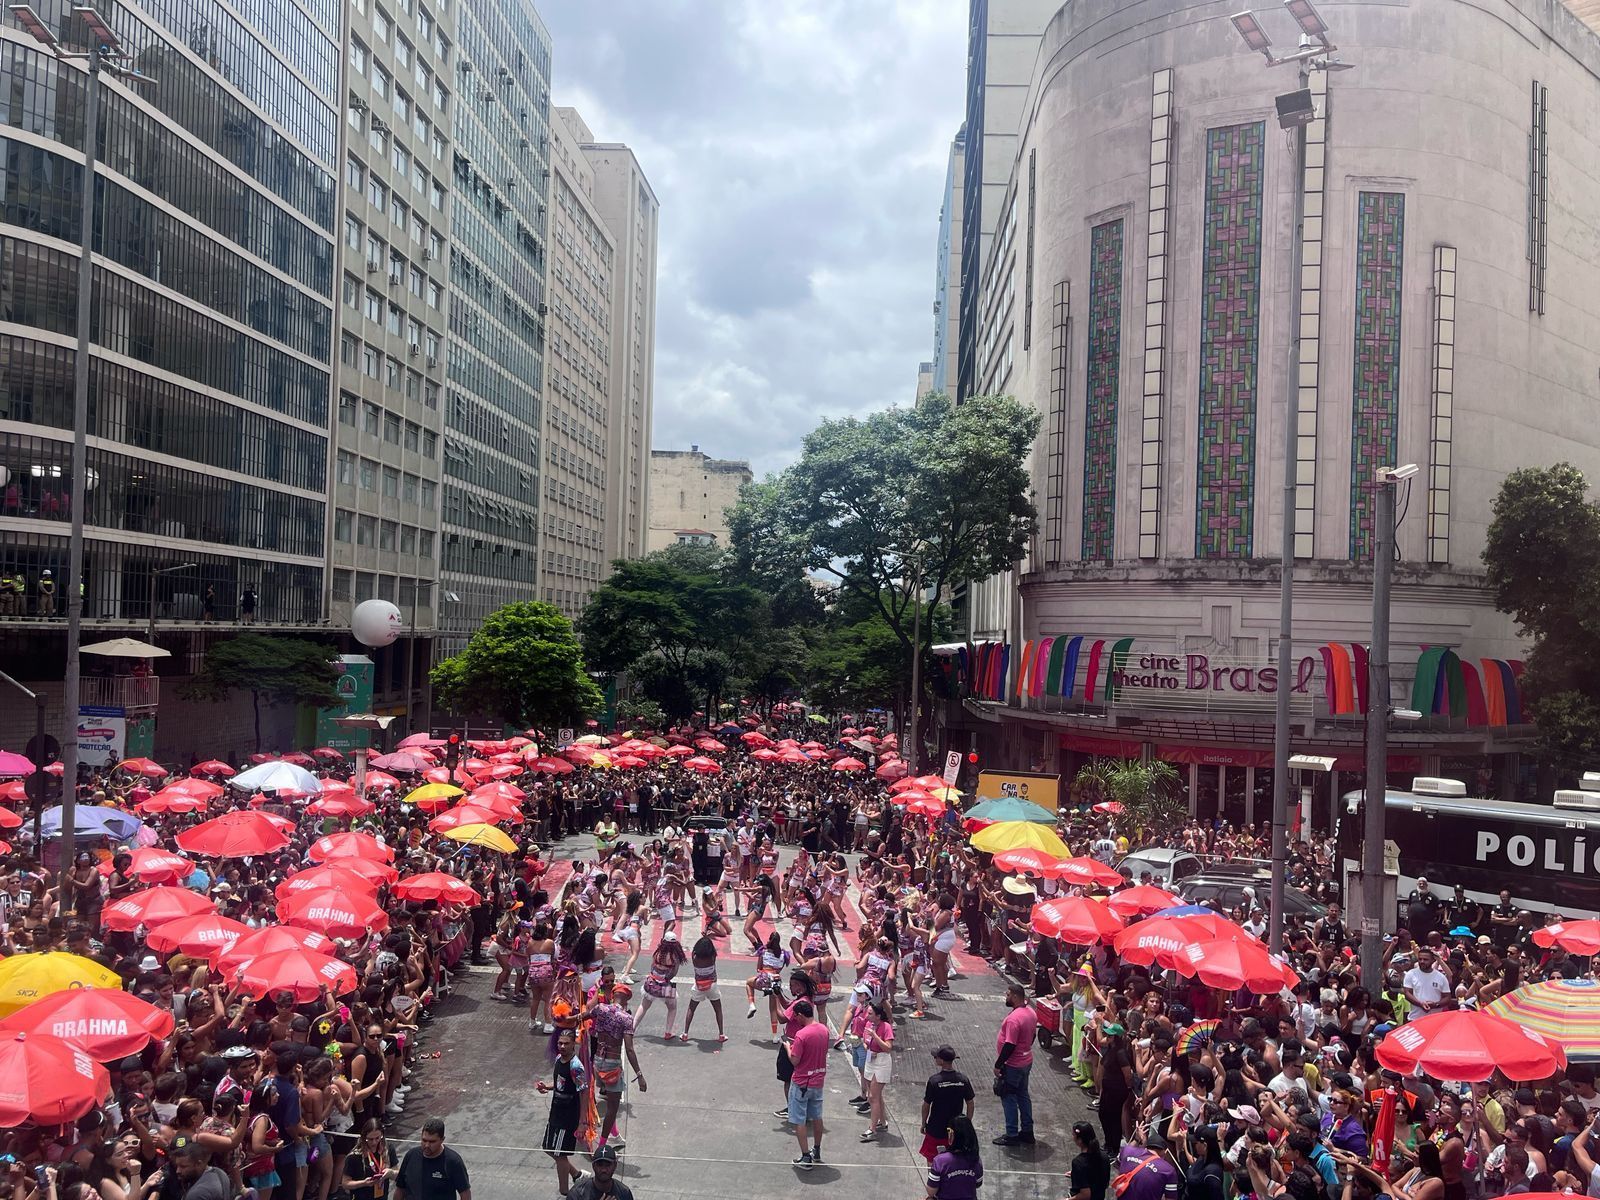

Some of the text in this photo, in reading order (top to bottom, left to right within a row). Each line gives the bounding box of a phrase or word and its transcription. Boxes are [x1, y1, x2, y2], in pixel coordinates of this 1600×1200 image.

[1139, 652, 1180, 670] cine
[1113, 668, 1179, 689] theatro
[1185, 654, 1315, 693] Brasl
[78, 743, 111, 752] PROTEÇÃO
[1100, 842, 1109, 850] 10
[307, 907, 355, 926] BRAHMA
[198, 928, 241, 942] BRAHM
[52, 1018, 128, 1038] BRAHMA
[1126, 1156, 1158, 1173] PRODÇÃO
[947, 1168, 976, 1179] PRODUÇÃO
